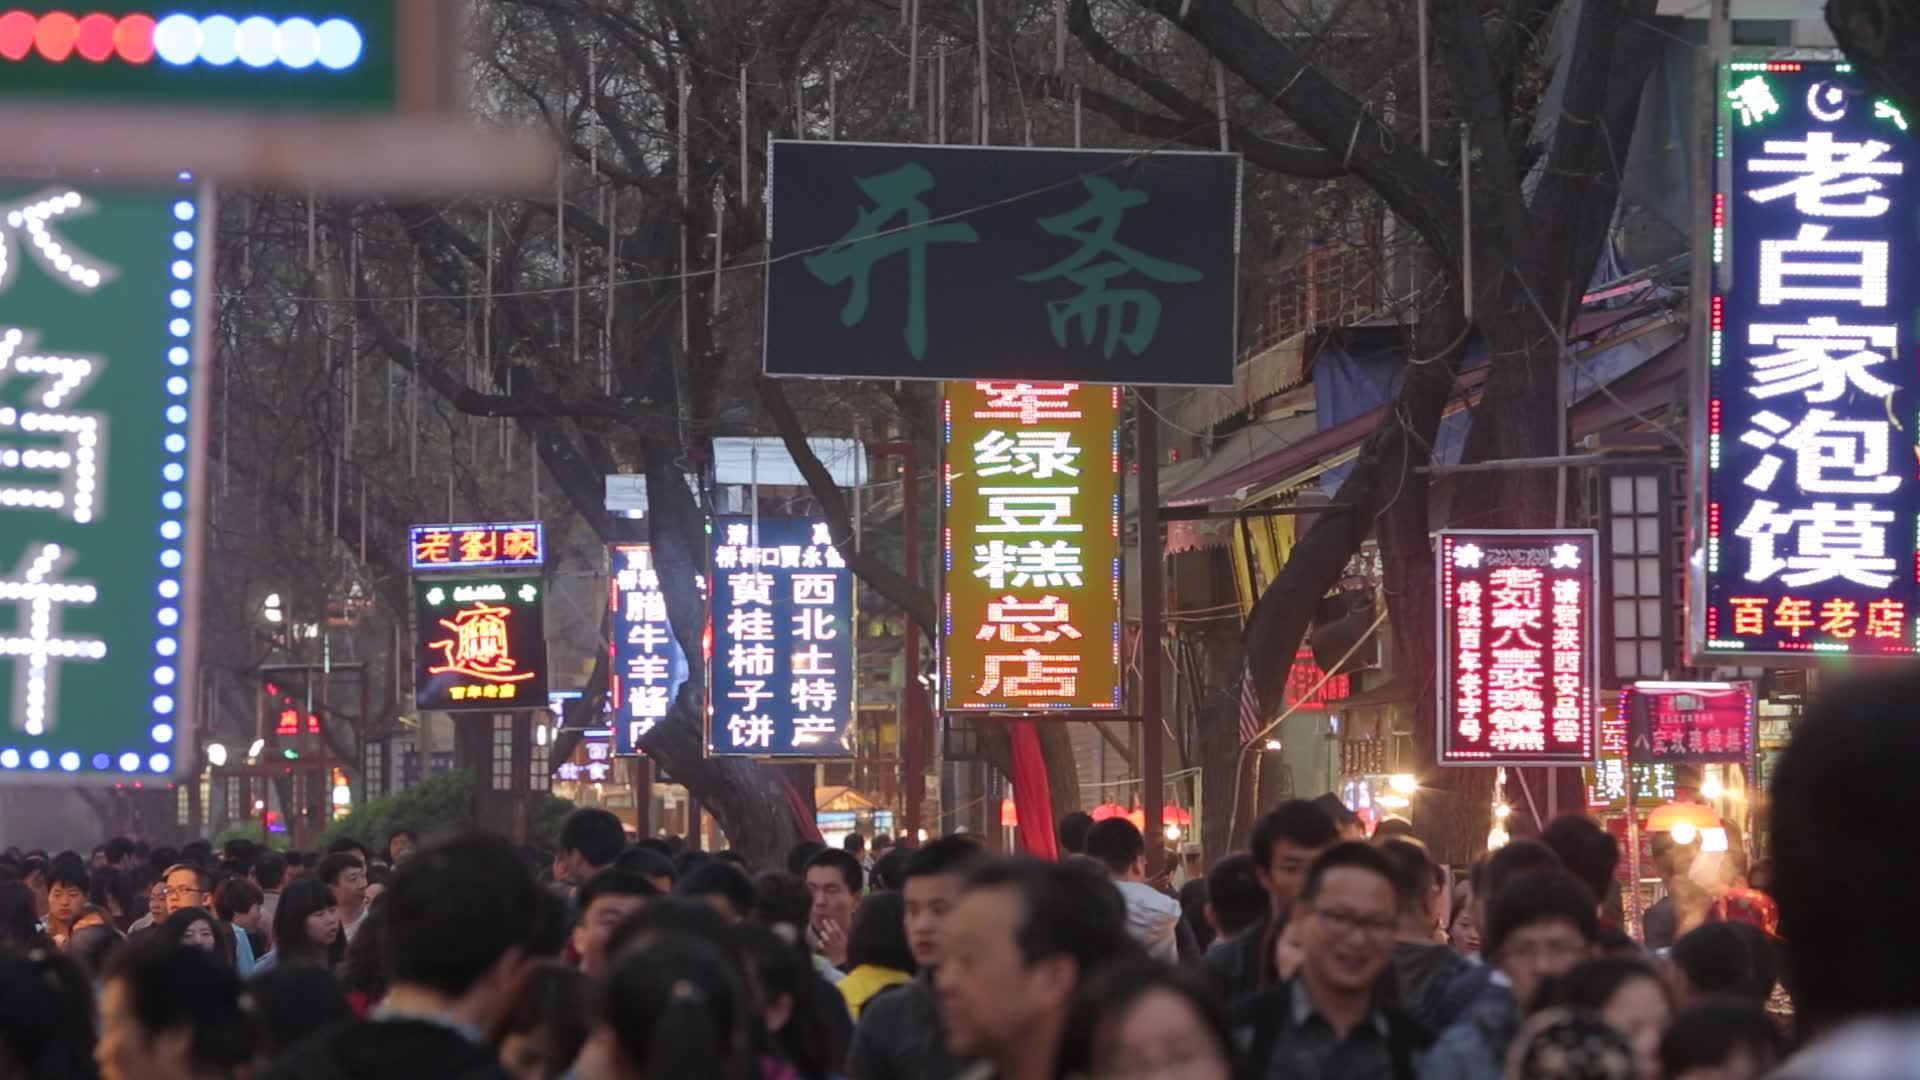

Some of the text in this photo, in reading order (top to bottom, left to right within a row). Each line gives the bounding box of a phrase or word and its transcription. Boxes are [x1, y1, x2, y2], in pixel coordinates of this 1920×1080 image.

[804, 161, 1204, 360] 开斋
[1734, 131, 1903, 588] 老白家泡馍
[416, 530, 538, 563] 老劉家
[1550, 543, 1581, 569] 真
[1730, 596, 1905, 639] 百年老店
[727, 572, 774, 747] 黄桂柿子饼
[791, 574, 837, 747] 西北土特产
